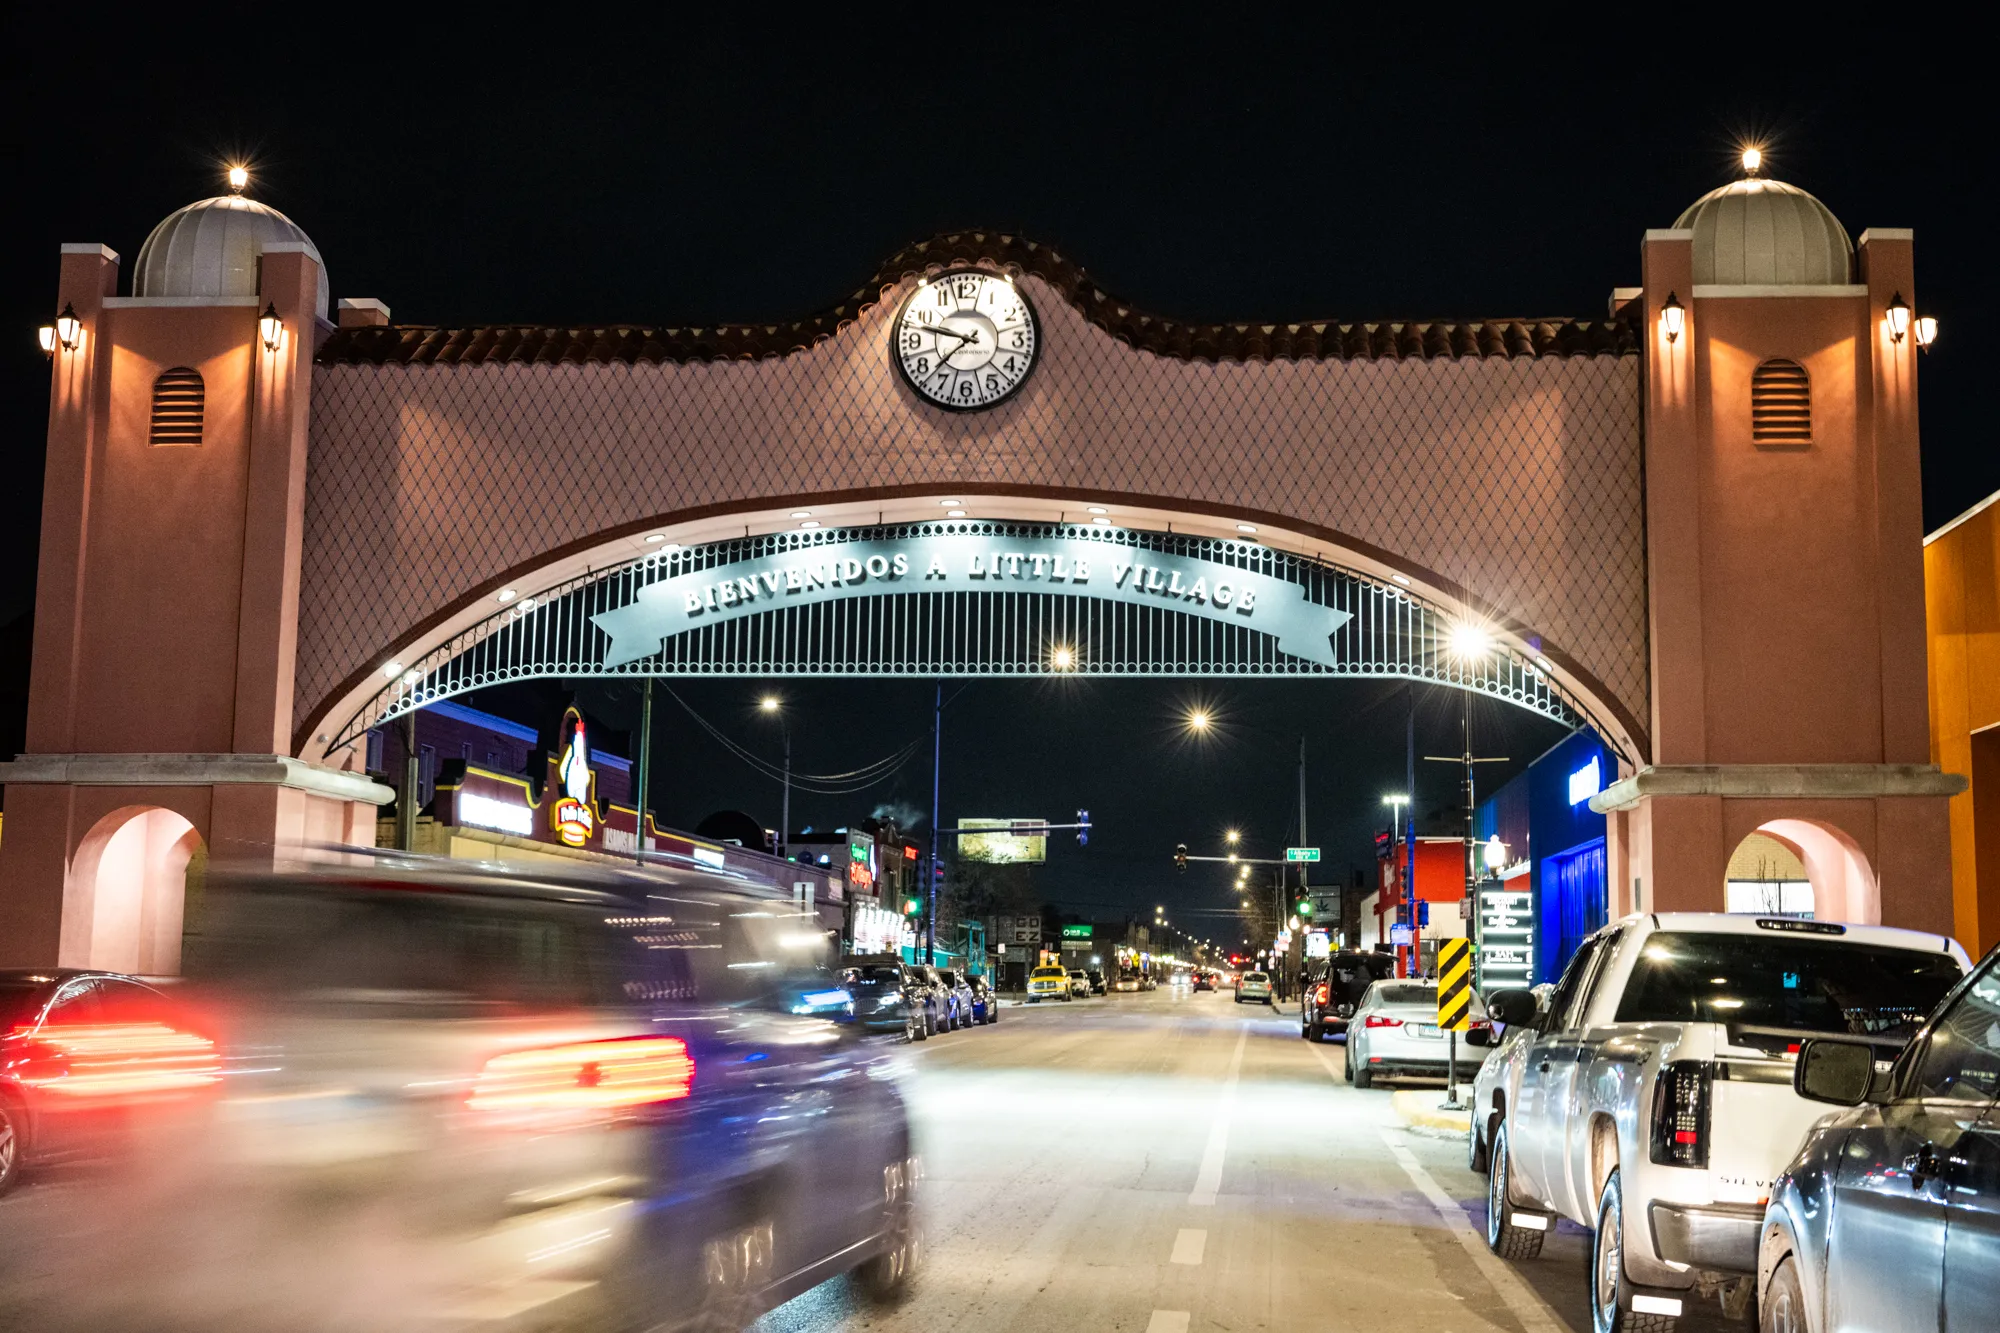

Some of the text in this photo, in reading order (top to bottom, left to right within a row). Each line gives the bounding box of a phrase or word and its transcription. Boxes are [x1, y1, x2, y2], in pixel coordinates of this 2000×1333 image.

[937, 289, 948, 307] 11
[957, 282, 976, 299] 12
[989, 291, 994, 305] 1
[918, 308, 933, 325] 10
[1004, 307, 1017, 322] 2
[908, 332, 921, 350] 9
[1011, 330, 1025, 349] 3
[916, 356, 929, 374] 8
[1002, 355, 1016, 373] 4
[937, 373, 949, 391] 7
[959, 380, 973, 398] 6
[986, 373, 998, 390] 5
[683, 552, 1257, 614] BIENVENIDOS A LITTLE VILLAGE
